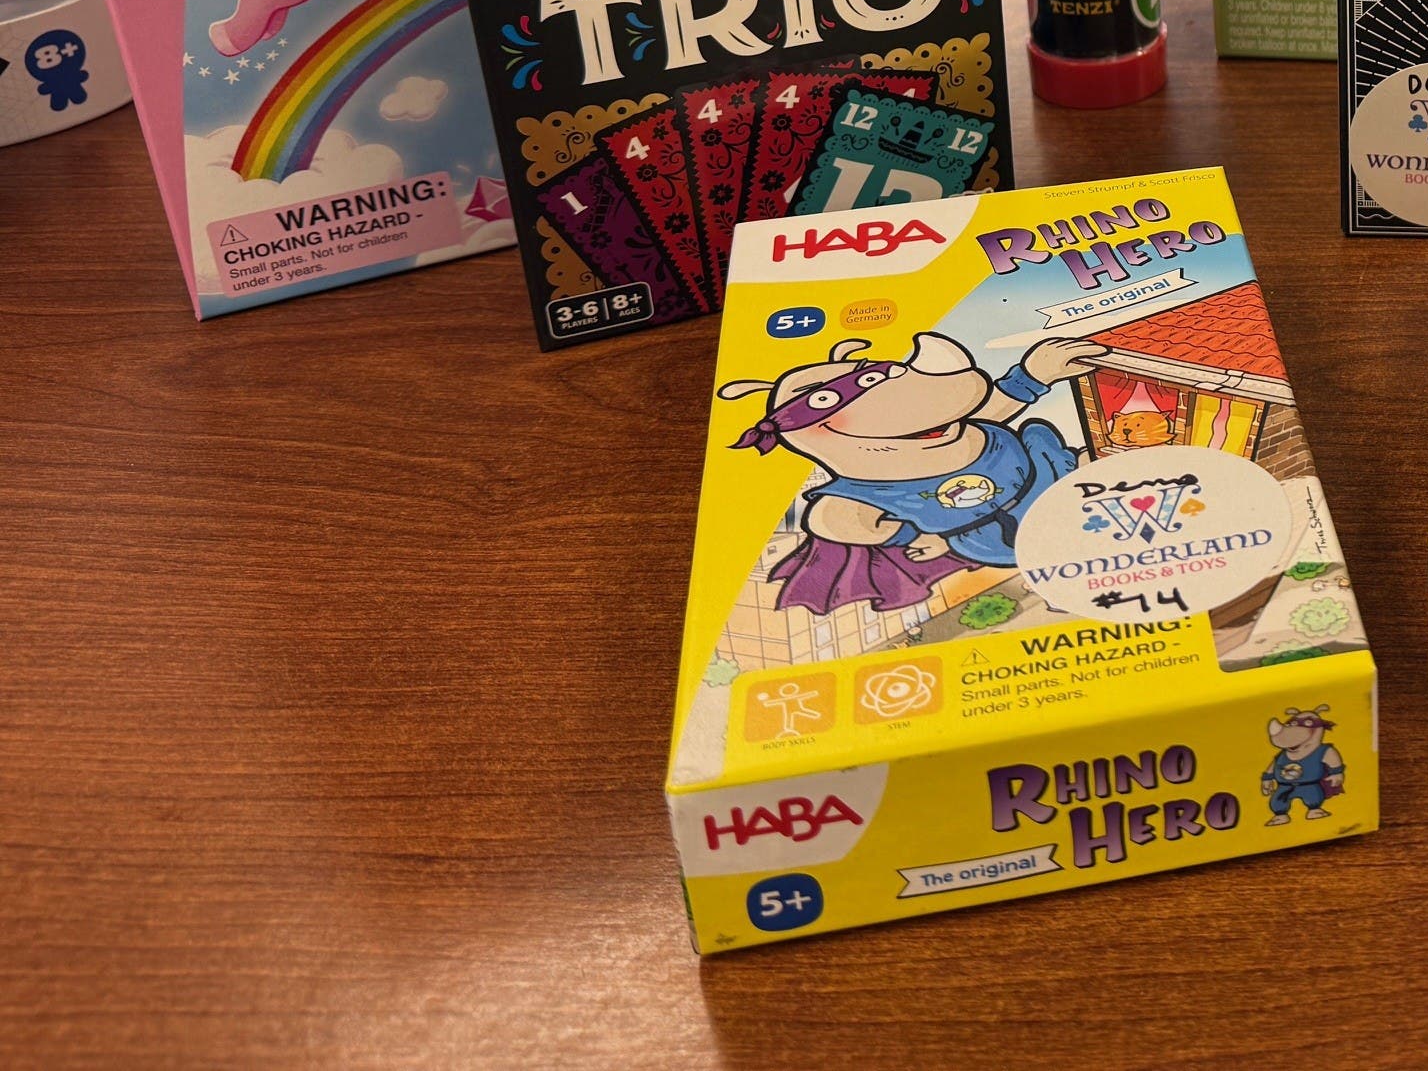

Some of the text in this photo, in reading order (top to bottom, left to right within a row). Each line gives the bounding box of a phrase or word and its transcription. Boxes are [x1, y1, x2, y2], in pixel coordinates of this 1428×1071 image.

[1050, 0, 1113, 16] TENZI
[35, 42, 78, 69] 8+
[775, 85, 800, 109] 4
[840, 103, 879, 131] 12
[948, 128, 984, 155] 12
[1044, 172, 1216, 200] Steven Strumpf Scott Frisco
[275, 180, 447, 232] WARNING:
[224, 212, 410, 264] CHOKING HAZARD
[772, 219, 947, 263] HABA
[977, 198, 1171, 275] RHINO
[229, 231, 408, 280] Small parts. Not for children
[1061, 220, 1227, 291] HERO
[233, 263, 327, 291] under 3 years.
[556, 300, 599, 322] 3-6
[612, 293, 643, 310] 8+
[620, 307, 641, 317] AGES
[848, 303, 890, 317] Made in
[1061, 278, 1171, 317] The original
[562, 316, 599, 330] PLAYERS
[774, 313, 817, 331] 5+
[846, 311, 892, 324] Germany
[1026, 529, 1272, 584] WONDERLAND
[1088, 557, 1227, 591] BOOKS TOYS
[961, 640, 1166, 686] CHOKING HAZARD
[986, 744, 1198, 835] RHINO
[704, 794, 865, 852] HABA
[1069, 792, 1241, 870] HERO
[920, 854, 1038, 889] The original
[759, 888, 812, 918] 5+
